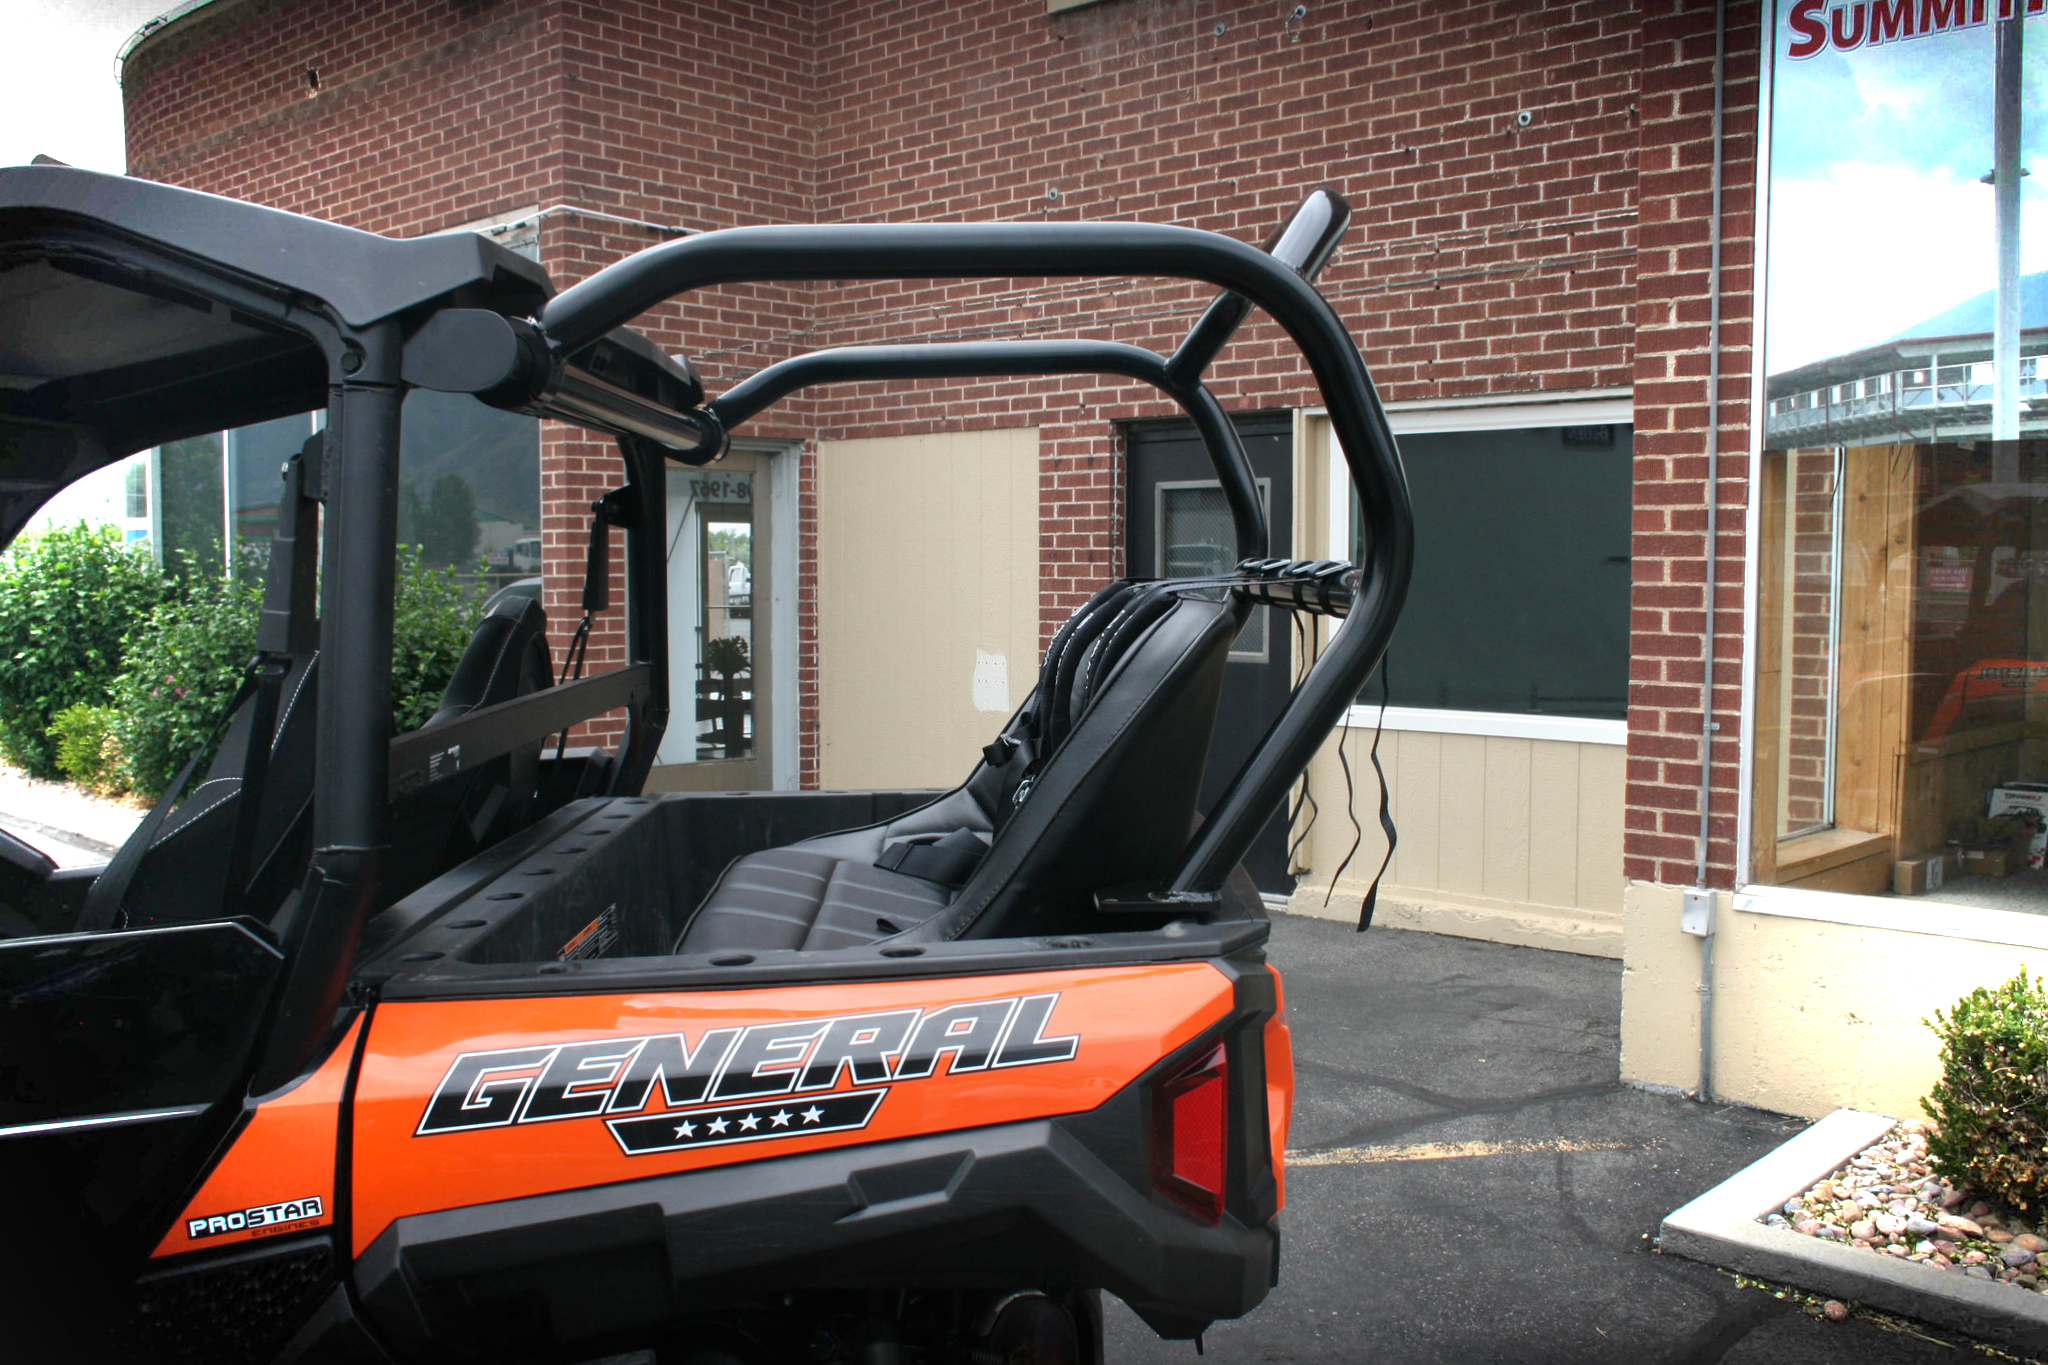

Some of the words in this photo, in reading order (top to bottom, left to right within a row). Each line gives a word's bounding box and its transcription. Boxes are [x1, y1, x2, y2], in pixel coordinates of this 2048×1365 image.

[412, 991, 1081, 1138] GENERAL
[188, 1197, 322, 1239] PROSTAR
[251, 1219, 321, 1238] ENGINES
